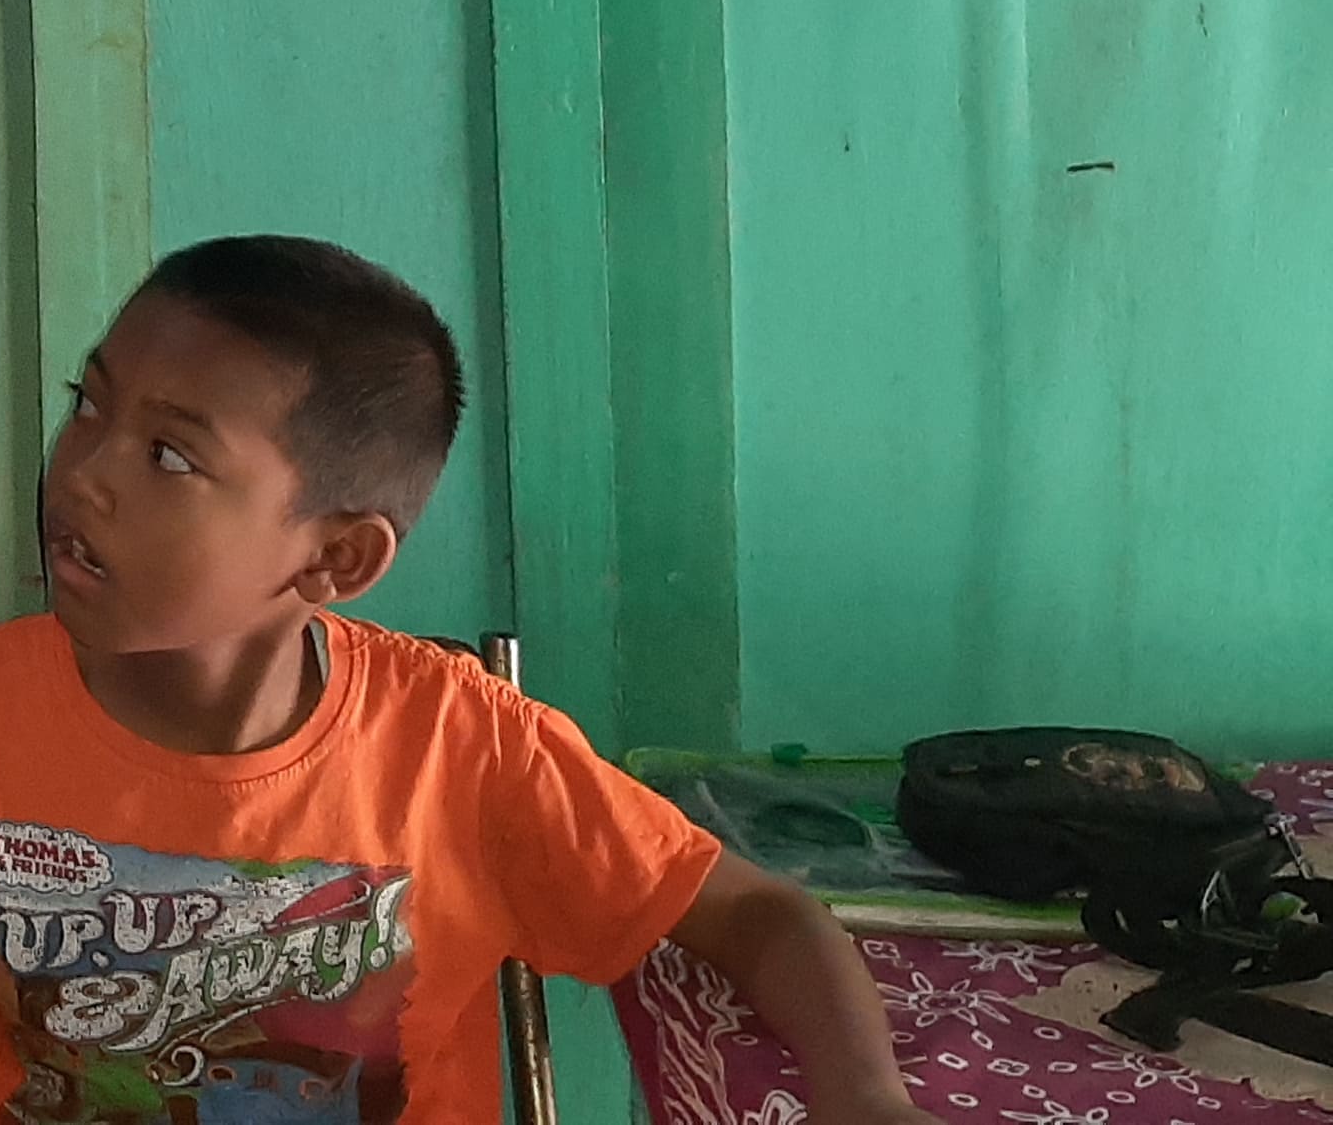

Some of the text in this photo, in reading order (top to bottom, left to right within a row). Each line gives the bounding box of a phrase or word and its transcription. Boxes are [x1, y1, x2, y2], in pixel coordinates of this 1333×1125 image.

[11, 858, 88, 884] FRIENDS
[102, 891, 220, 955] UP
[43, 876, 414, 1052] & AWAY!
